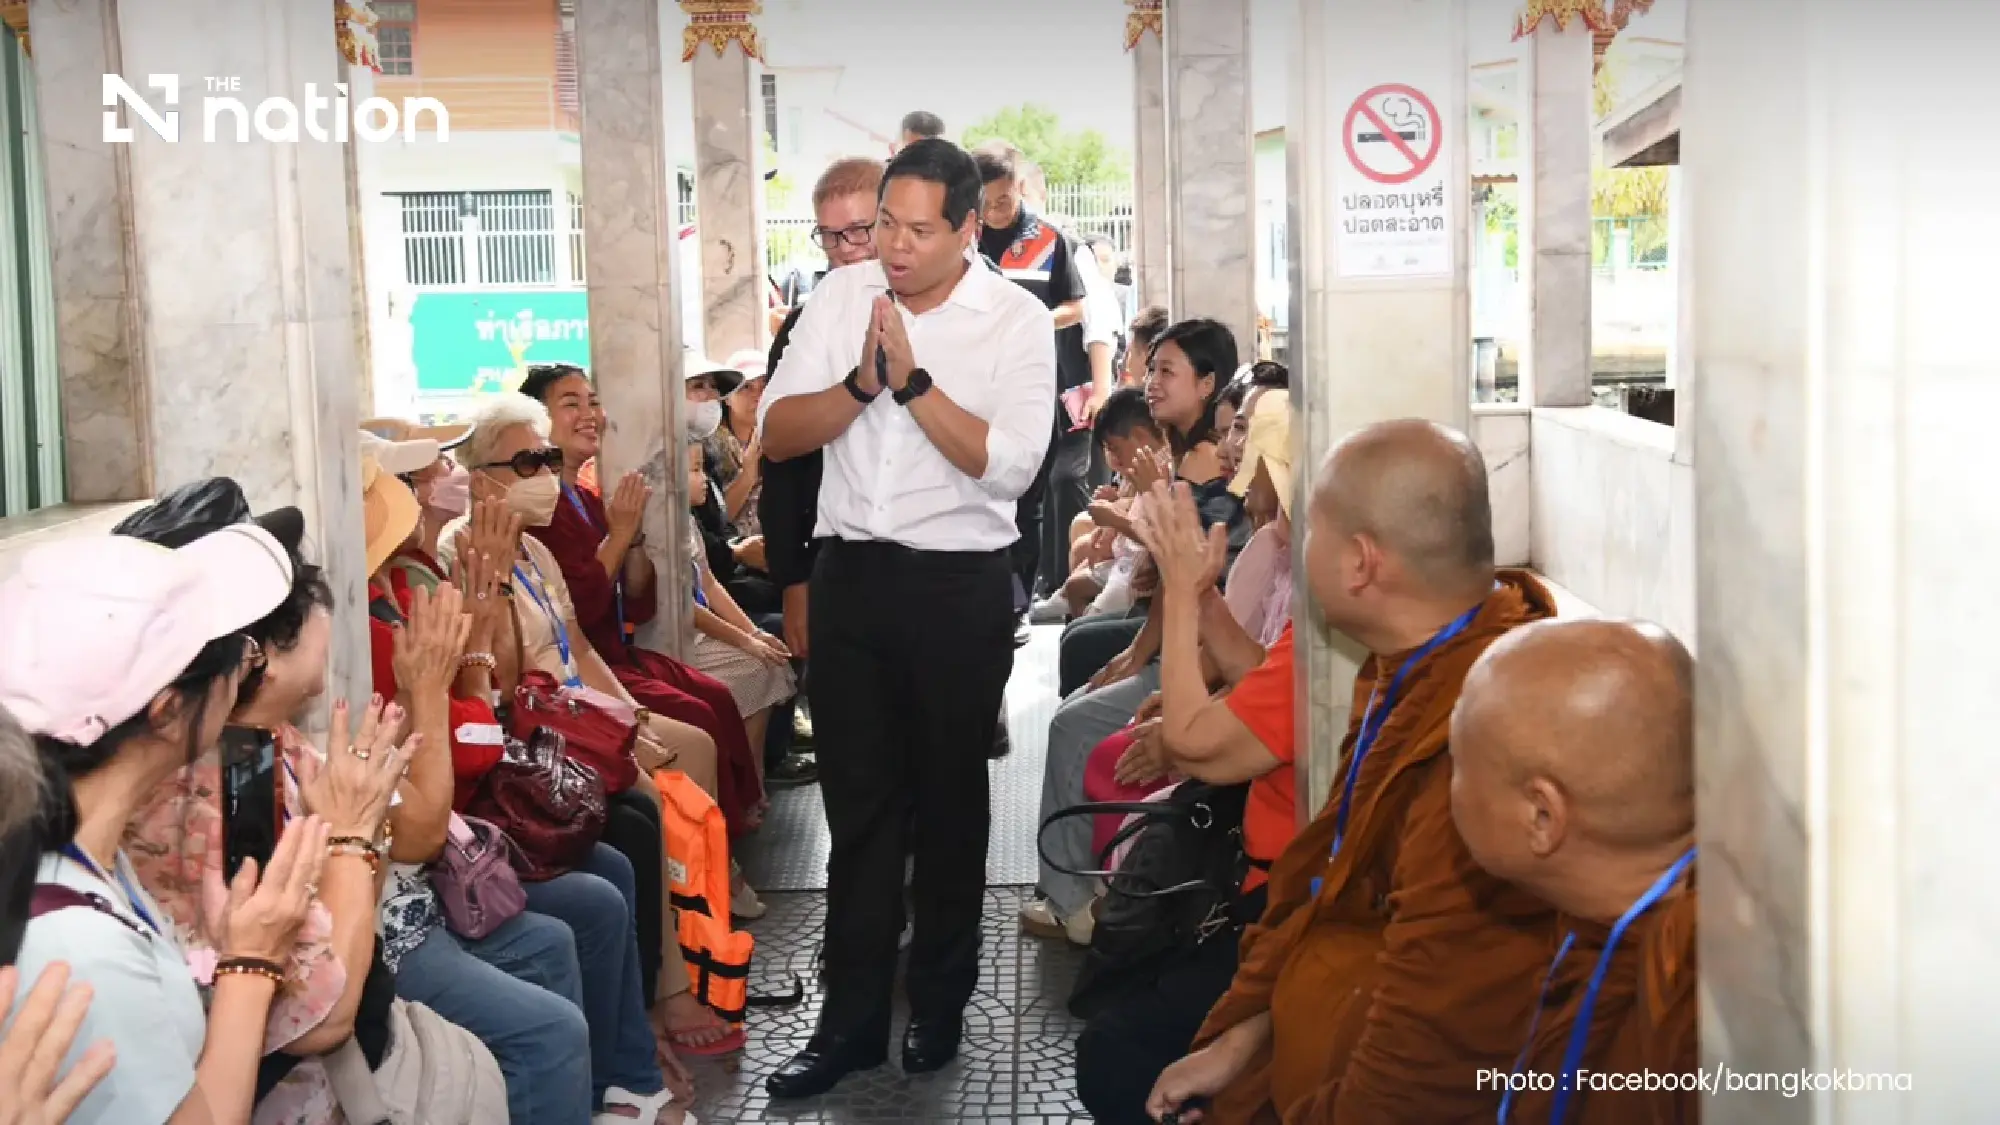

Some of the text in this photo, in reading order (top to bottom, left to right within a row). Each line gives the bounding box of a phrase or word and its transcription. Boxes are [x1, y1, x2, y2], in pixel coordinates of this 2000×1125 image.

[1342, 180, 1444, 215] ปลอดบุหรี่
[1342, 215, 1444, 234] ปอดสะอาด
[474, 308, 589, 341] ท่าเรือภา
